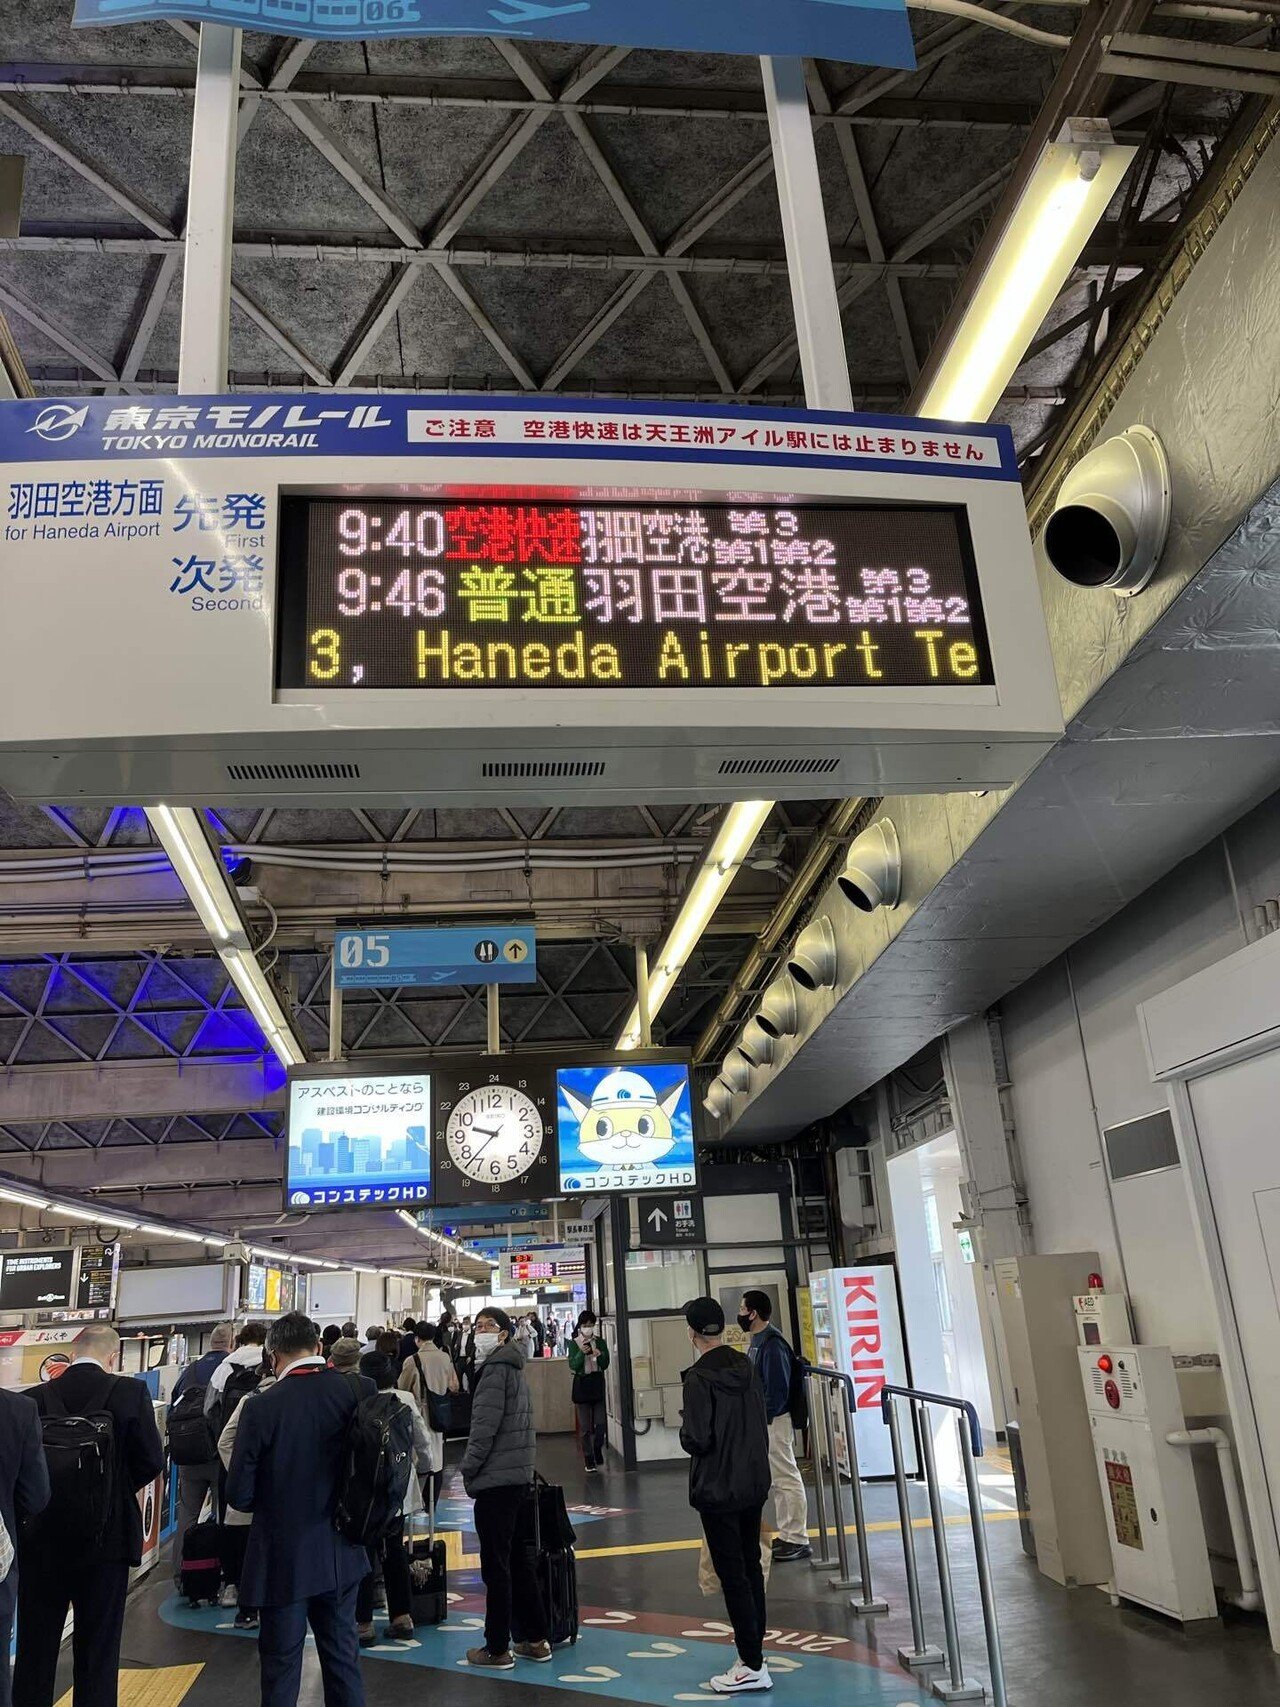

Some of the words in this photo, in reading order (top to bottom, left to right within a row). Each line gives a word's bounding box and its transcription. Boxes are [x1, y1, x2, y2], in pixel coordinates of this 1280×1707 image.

[103, 405, 391, 431] 東京モノレール
[101, 434, 186, 451] TOKYO
[192, 433, 319, 449] MONORAIL
[425, 419, 496, 438] ご注意
[523, 420, 984, 461] 空港快速は天王洲アイル駅には止まりません
[7, 479, 164, 520] 羽田空港方面
[173, 492, 267, 534] 先発
[5, 525, 28, 541] for
[33, 524, 99, 540] Haneda
[104, 522, 161, 541] Airport
[338, 509, 444, 557] 9:40
[445, 507, 582, 564] 空港快速
[580, 509, 709, 565] 羽田空港
[225, 533, 265, 548] First
[169, 553, 264, 595] 次発
[338, 568, 445, 617] 9:46
[457, 565, 582, 623] 普通
[582, 567, 841, 624] 羽田空港
[191, 596, 263, 611] Second
[310, 628, 365, 684] 3,
[417, 629, 622, 679] Haneda
[658, 630, 883, 686] Airport
[914, 630, 978, 678] Te
[340, 935, 390, 968] 05
[489, 1074, 500, 1082] 24
[298, 1082, 424, 1100] アスベストのことなら
[458, 1082, 470, 1091] 23
[440, 1102, 451, 1110] 22
[488, 1094, 502, 1109] 12
[458, 1112, 473, 1127] 10
[519, 1107, 529, 1122] 2
[454, 1130, 465, 1144] 9
[523, 1124, 534, 1139] 3
[461, 1145, 472, 1160] 8
[519, 1141, 530, 1156] 4
[440, 1160, 451, 1169] 20
[475, 1157, 485, 1172] 7
[490, 1160, 501, 1175] 6
[507, 1155, 518, 1170] 5
[585, 1173, 692, 1189] コンステックHD
[313, 1186, 428, 1204] コンステックHD
[843, 1276, 887, 1409] KIRIN
